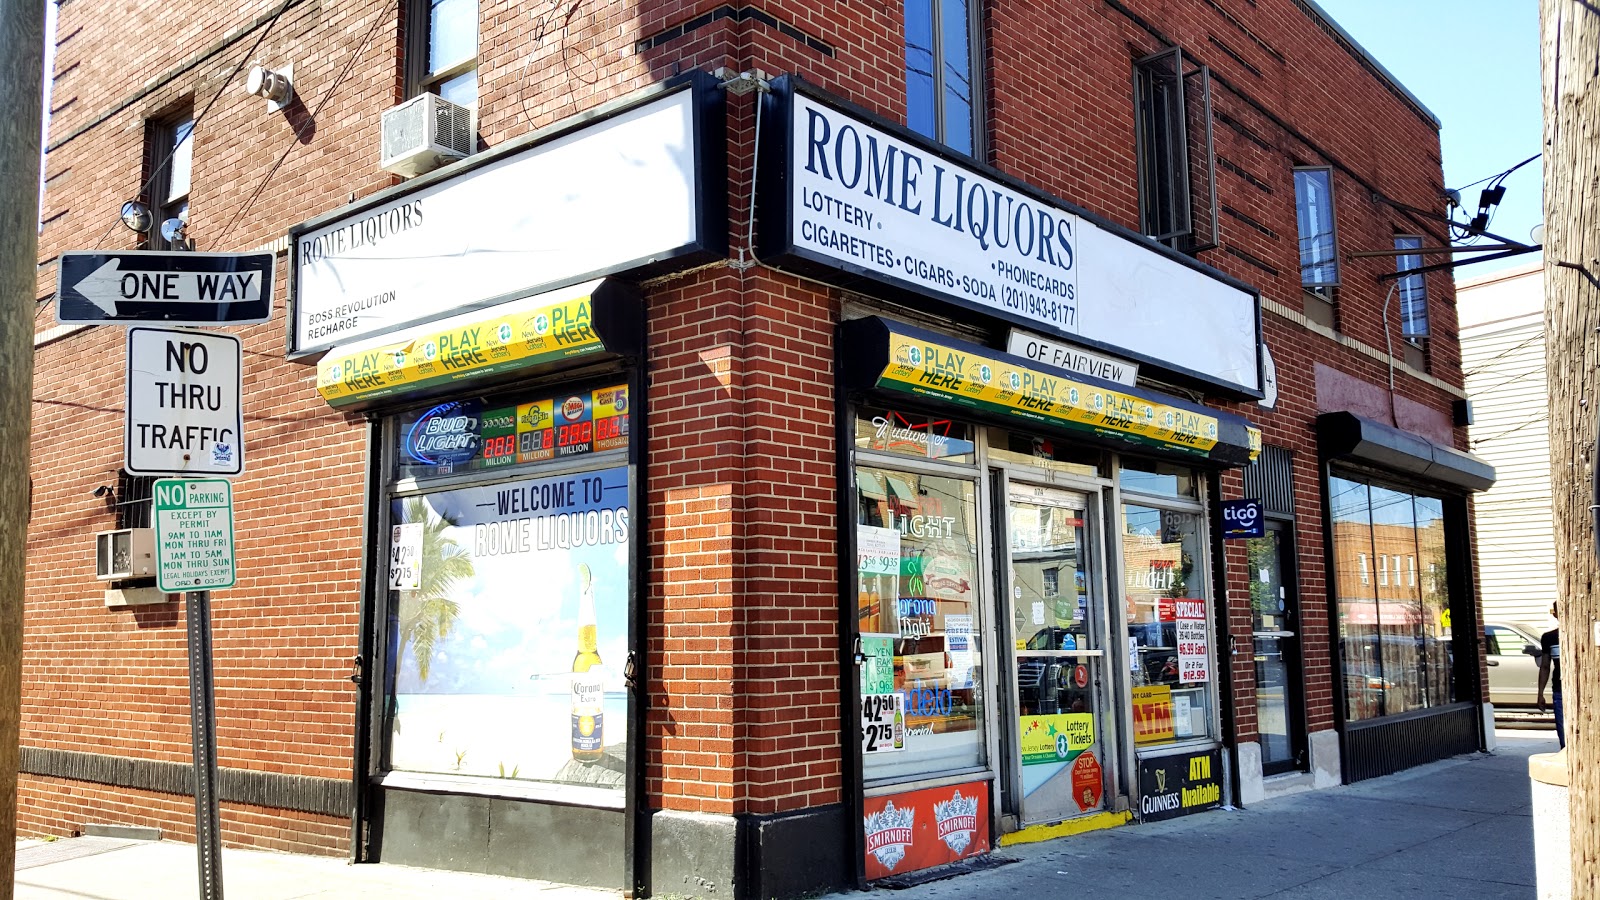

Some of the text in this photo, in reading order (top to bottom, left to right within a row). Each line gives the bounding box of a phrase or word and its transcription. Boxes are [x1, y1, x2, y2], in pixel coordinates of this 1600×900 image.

[805, 106, 1074, 271] ROME LIQUORS
[803, 187, 873, 230] LOTTERY
[302, 199, 423, 266] ROME LIQUORS
[802, 220, 1076, 326] CIGARETTES CIGARS SODA (201)943-8177
[998, 260, 1075, 300] PHONECARDS
[120, 273, 254, 300] ONE WAY
[308, 290, 396, 326] BOSS REVOLUTION
[552, 300, 592, 327] PLA
[308, 317, 358, 340] RECHARGE
[553, 320, 597, 346] HER
[440, 327, 480, 354] PLAY
[166, 340, 209, 375] NO
[344, 352, 379, 376] PLAY
[440, 346, 487, 370] HERE
[896, 355, 908, 363] New
[898, 363, 915, 372] Jersey
[925, 346, 965, 373] PLAY
[1027, 342, 1048, 360] OF
[1053, 349, 1124, 381] FAIRVIEW
[344, 369, 386, 391] HERE
[892, 368, 912, 378] Lottery
[919, 366, 964, 390] HERE
[964, 385, 983, 395] Lottery
[1023, 372, 1057, 396] PLAY
[155, 382, 221, 411] THRU
[614, 389, 627, 412] 5
[1017, 390, 1056, 412] HERE
[1106, 393, 1135, 414] PLAY
[426, 416, 470, 435] BUD
[1101, 410, 1133, 429] HERE
[1176, 411, 1199, 431] PLAY
[137, 424, 233, 451] TRAFFIC
[416, 433, 475, 451] LIGHT
[598, 436, 629, 448] THOUSAN
[1170, 427, 1199, 444] HERE
[523, 450, 550, 461] MILLION
[561, 443, 589, 455] MILLION
[486, 456, 512, 466] MILLION
[157, 485, 225, 506] NO PARKING
[498, 477, 603, 515] WELCOME TO
[171, 511, 202, 519] EXCEPT
[1224, 504, 1258, 521] tigo
[180, 520, 210, 529] PERMIT
[475, 505, 629, 557] ROME LIQUORS
[888, 509, 956, 539] LIGHT
[165, 539, 227, 549] MON THRU FRI
[168, 530, 223, 540] 9AM TO 11AM
[164, 558, 230, 570] MON THRU SUN
[170, 550, 223, 560] 1AM TO 5AM
[164, 571, 180, 580] LEGAL
[182, 570, 208, 578] HOLIDAYS
[897, 597, 937, 617] orona
[1176, 601, 1205, 619] SPECIAL!
[1195, 643, 1206, 655] Each
[1184, 671, 1206, 681] $12.99
[574, 682, 600, 695] Corona
[1066, 720, 1089, 735] Lottery
[1133, 701, 1173, 735] ATM
[1040, 743, 1055, 751] Lottery
[1071, 733, 1092, 745] Tickets
[1079, 757, 1094, 768] STOP
[1189, 756, 1211, 781] ATM
[1142, 792, 1179, 815] GUINNESS
[1182, 783, 1220, 808] Available
[940, 816, 975, 836] SMIRNOFF
[869, 829, 911, 853] SMIRNOFF
